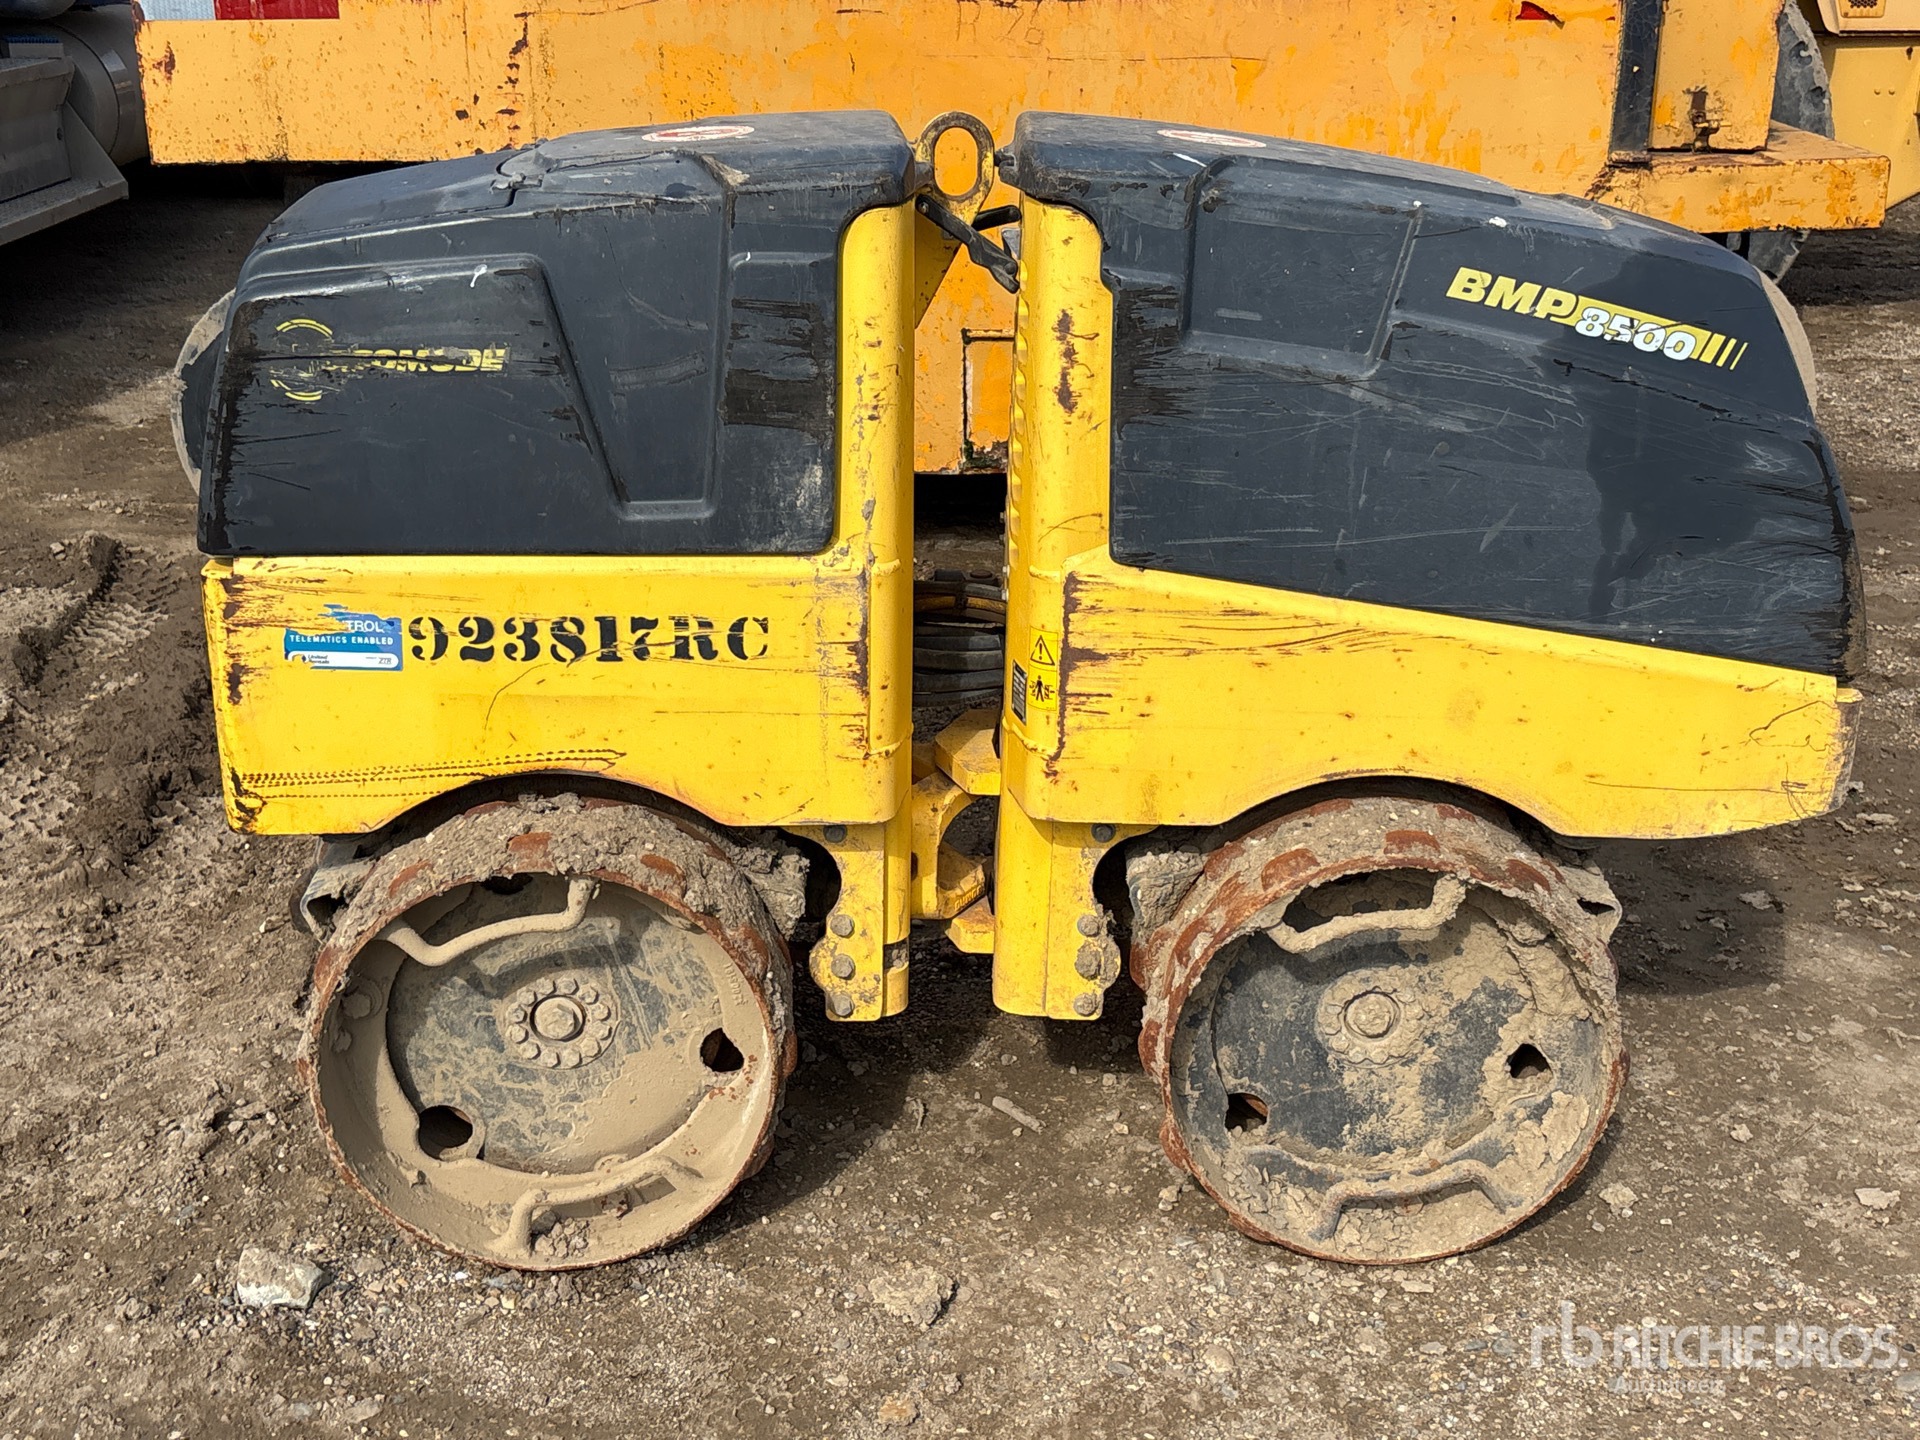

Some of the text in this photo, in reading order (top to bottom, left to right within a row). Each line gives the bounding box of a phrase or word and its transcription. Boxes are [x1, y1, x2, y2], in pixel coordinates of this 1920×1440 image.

[1446, 266, 1697, 361] BMP 8500
[289, 634, 394, 645] TELEMATICS ENABLED
[344, 620, 385, 633] TROL
[409, 615, 769, 663] 923817RC
